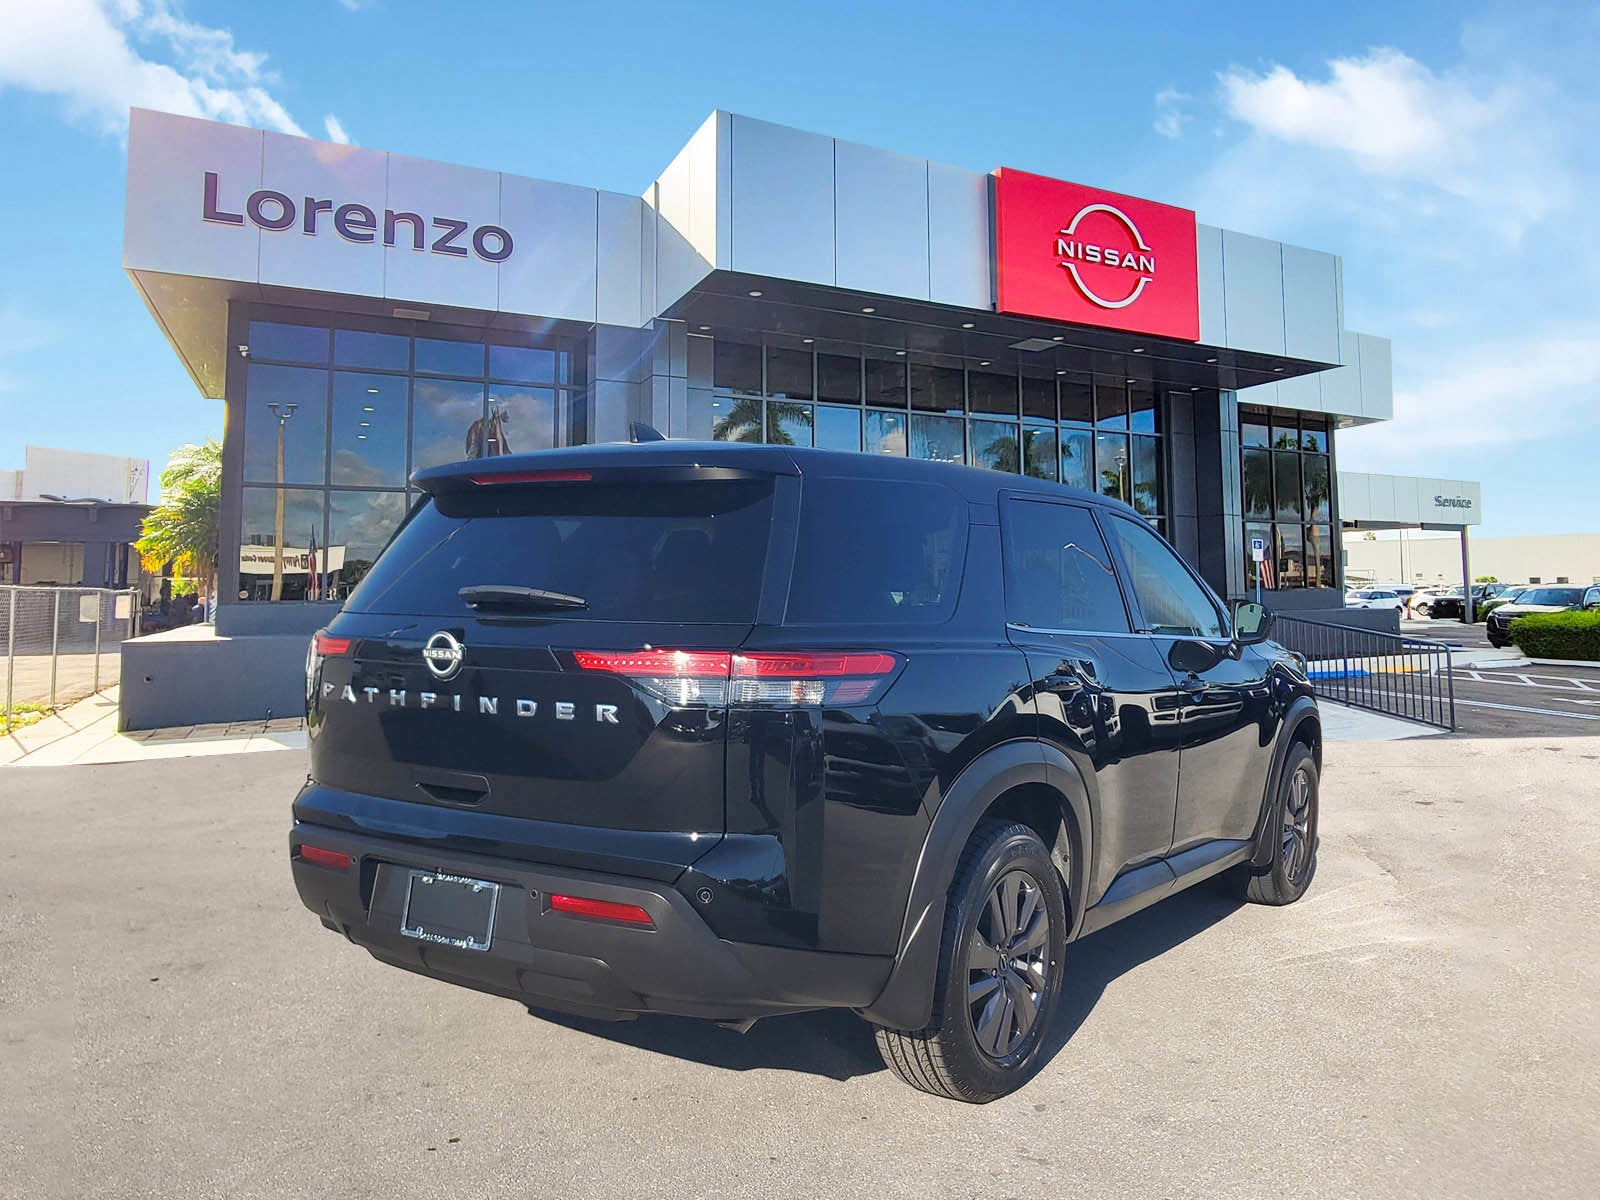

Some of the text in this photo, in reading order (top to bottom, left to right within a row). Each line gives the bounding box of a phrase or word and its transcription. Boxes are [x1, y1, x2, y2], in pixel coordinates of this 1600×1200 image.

[203, 171, 514, 262] Lorenzo
[1057, 238, 1155, 273] NISSAN
[1434, 495, 1472, 509] Service
[423, 649, 462, 660] NISSAN
[323, 682, 619, 724] PATHFINDER
